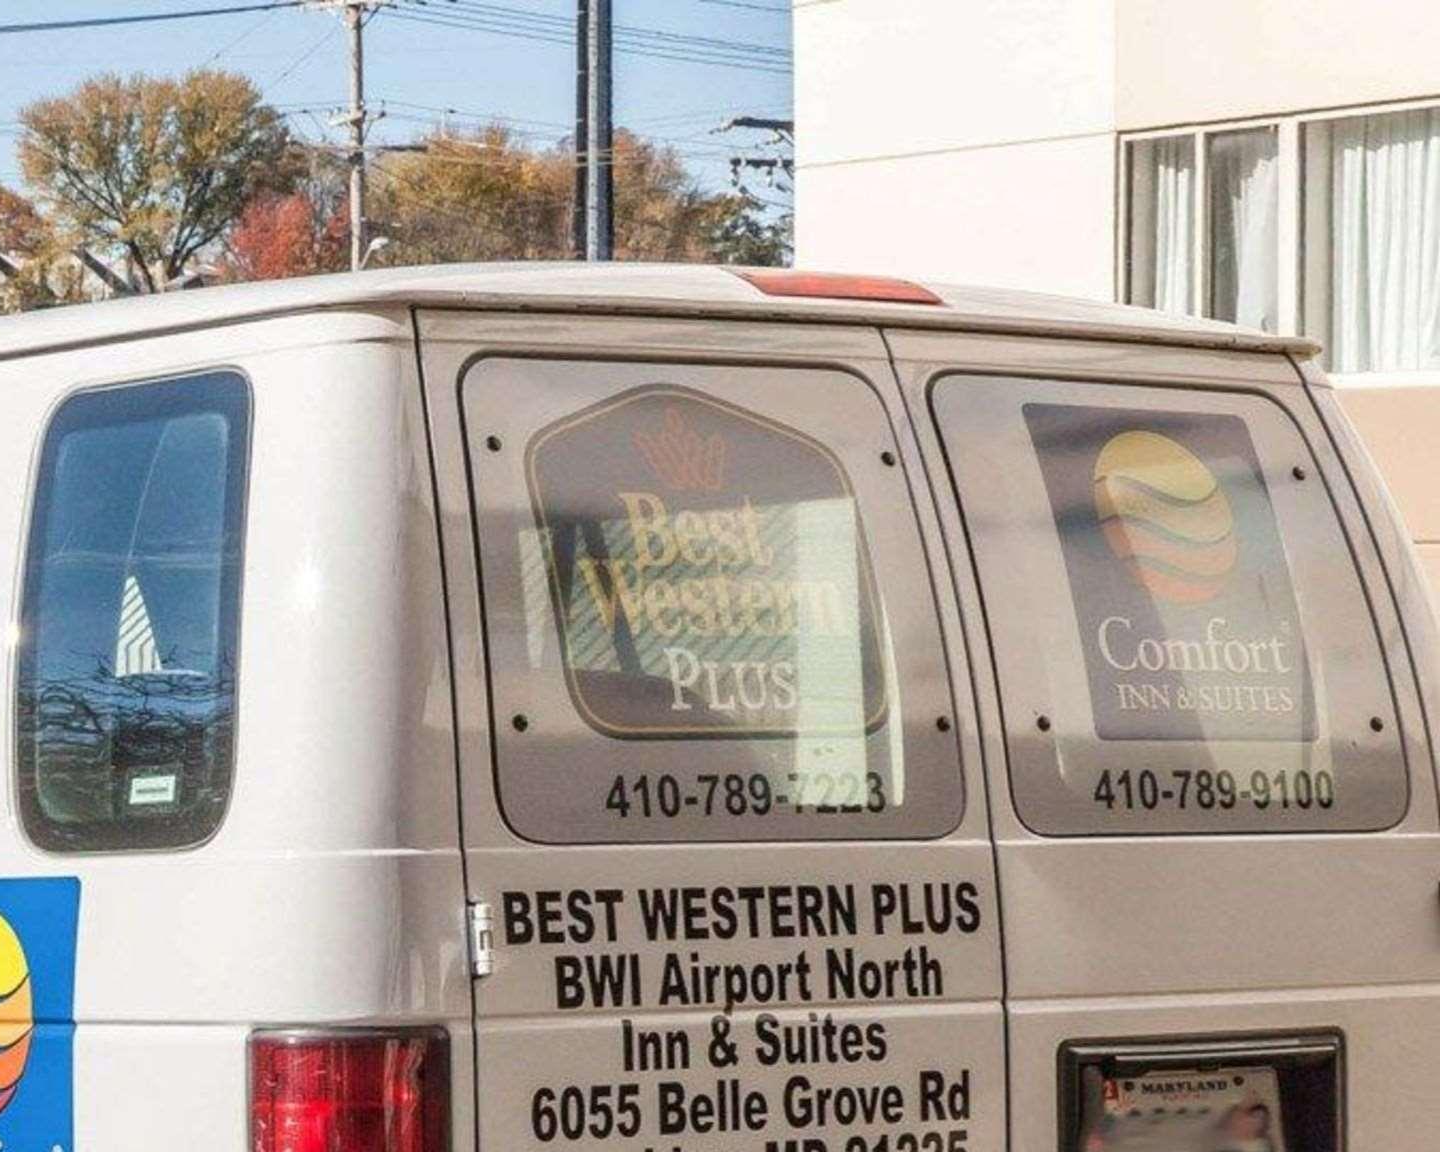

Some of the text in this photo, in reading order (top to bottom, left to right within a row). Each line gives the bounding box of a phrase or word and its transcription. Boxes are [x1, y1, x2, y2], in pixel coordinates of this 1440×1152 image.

[617, 492, 772, 570] Best
[576, 555, 839, 638] Western
[1097, 616, 1291, 673] Comfort
[663, 647, 797, 711] PLUS
[1117, 684, 1296, 712] INN & SUITES
[605, 772, 886, 818] 410-789-7223
[1093, 769, 1334, 810] 410-789-9100
[502, 882, 981, 946] BEST WESTERN PLUS
[555, 946, 943, 1015] BWI Airport North
[622, 1013, 888, 1072] Inn & Suites
[532, 1069, 971, 1142] 6055 Belle Grove Rd
[1141, 1080, 1228, 1095] MARYLAND
